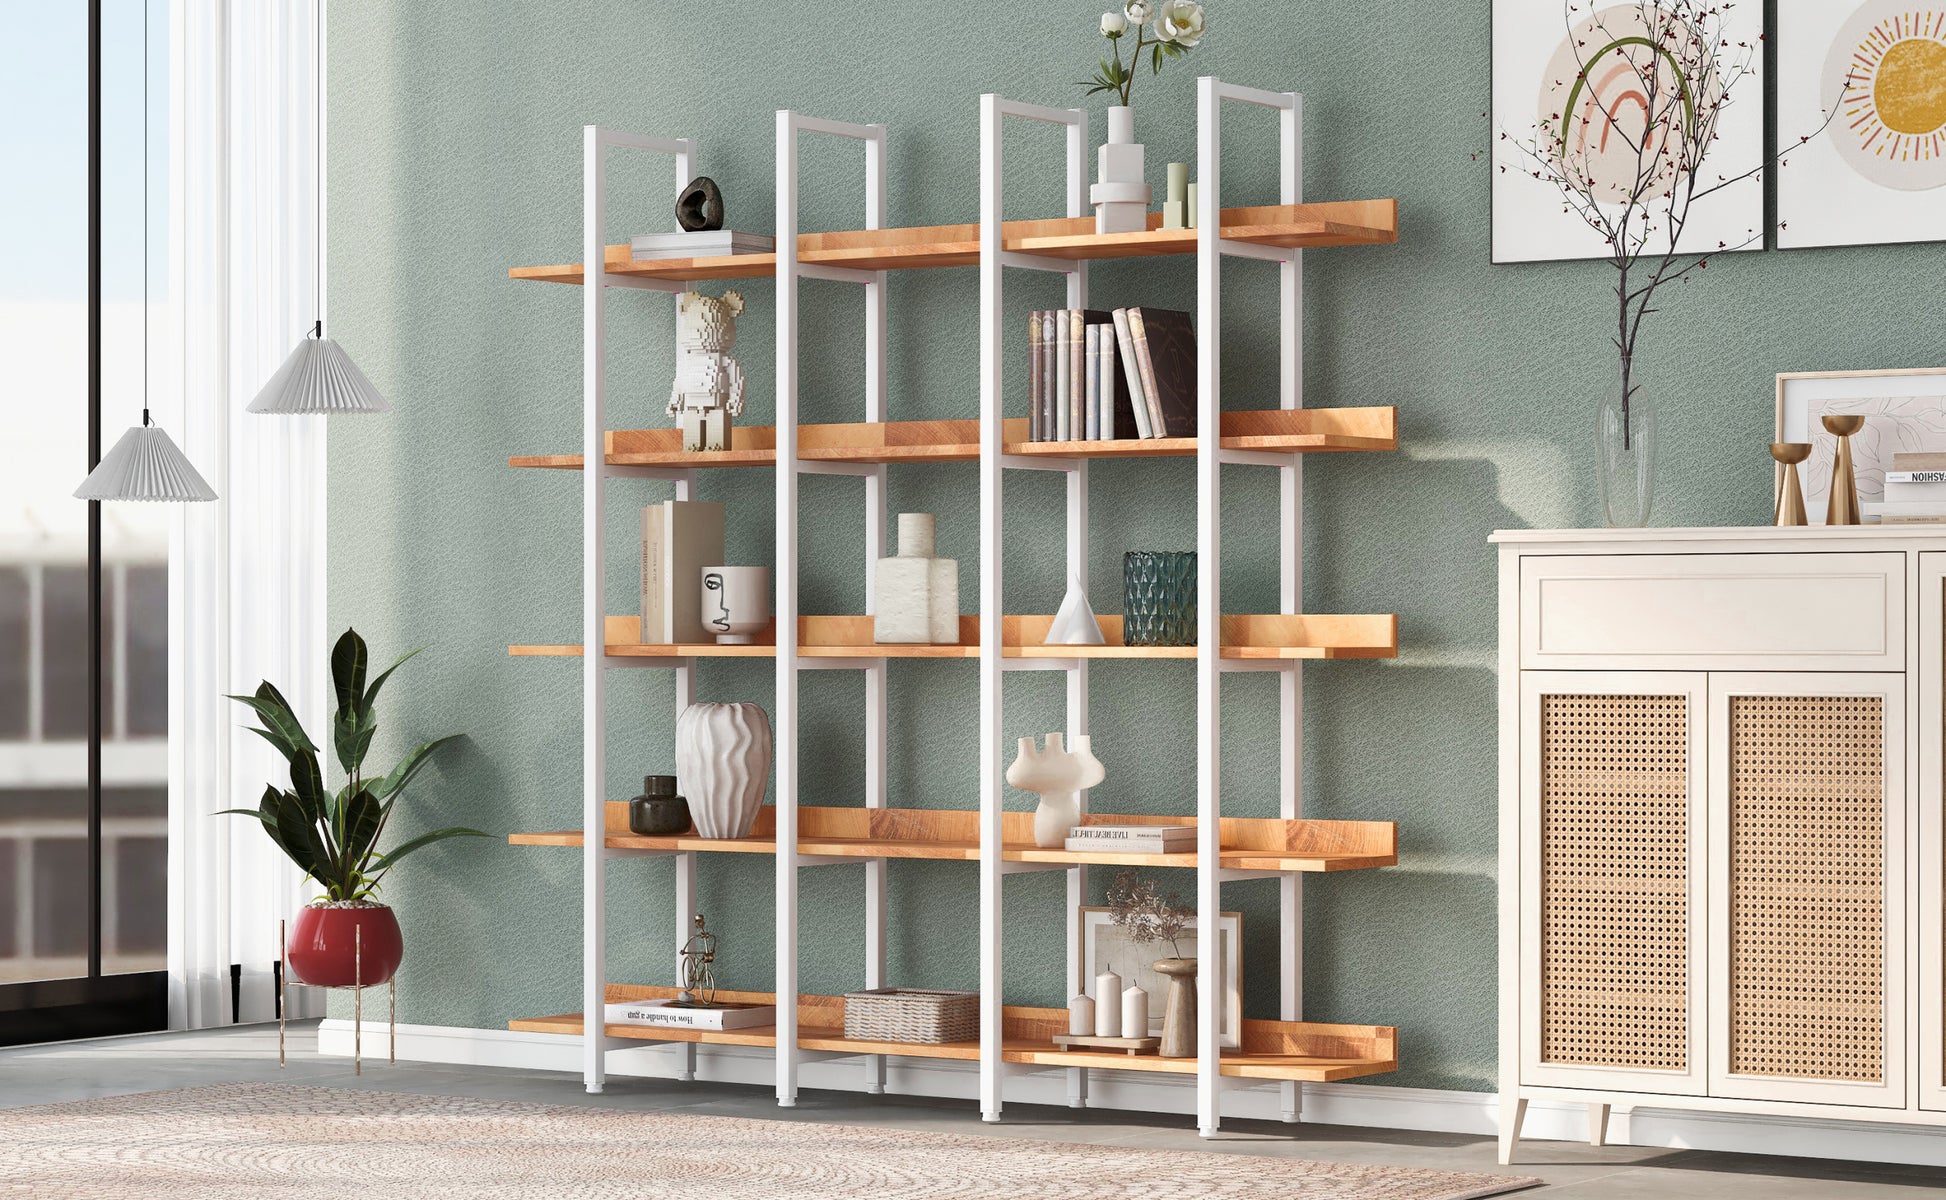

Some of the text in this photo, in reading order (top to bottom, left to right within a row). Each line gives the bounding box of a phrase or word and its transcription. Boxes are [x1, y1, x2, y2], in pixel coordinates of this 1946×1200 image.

[646, 1013, 669, 1023] handle
[669, 1015, 677, 1023] to
[678, 1016, 693, 1025] How
